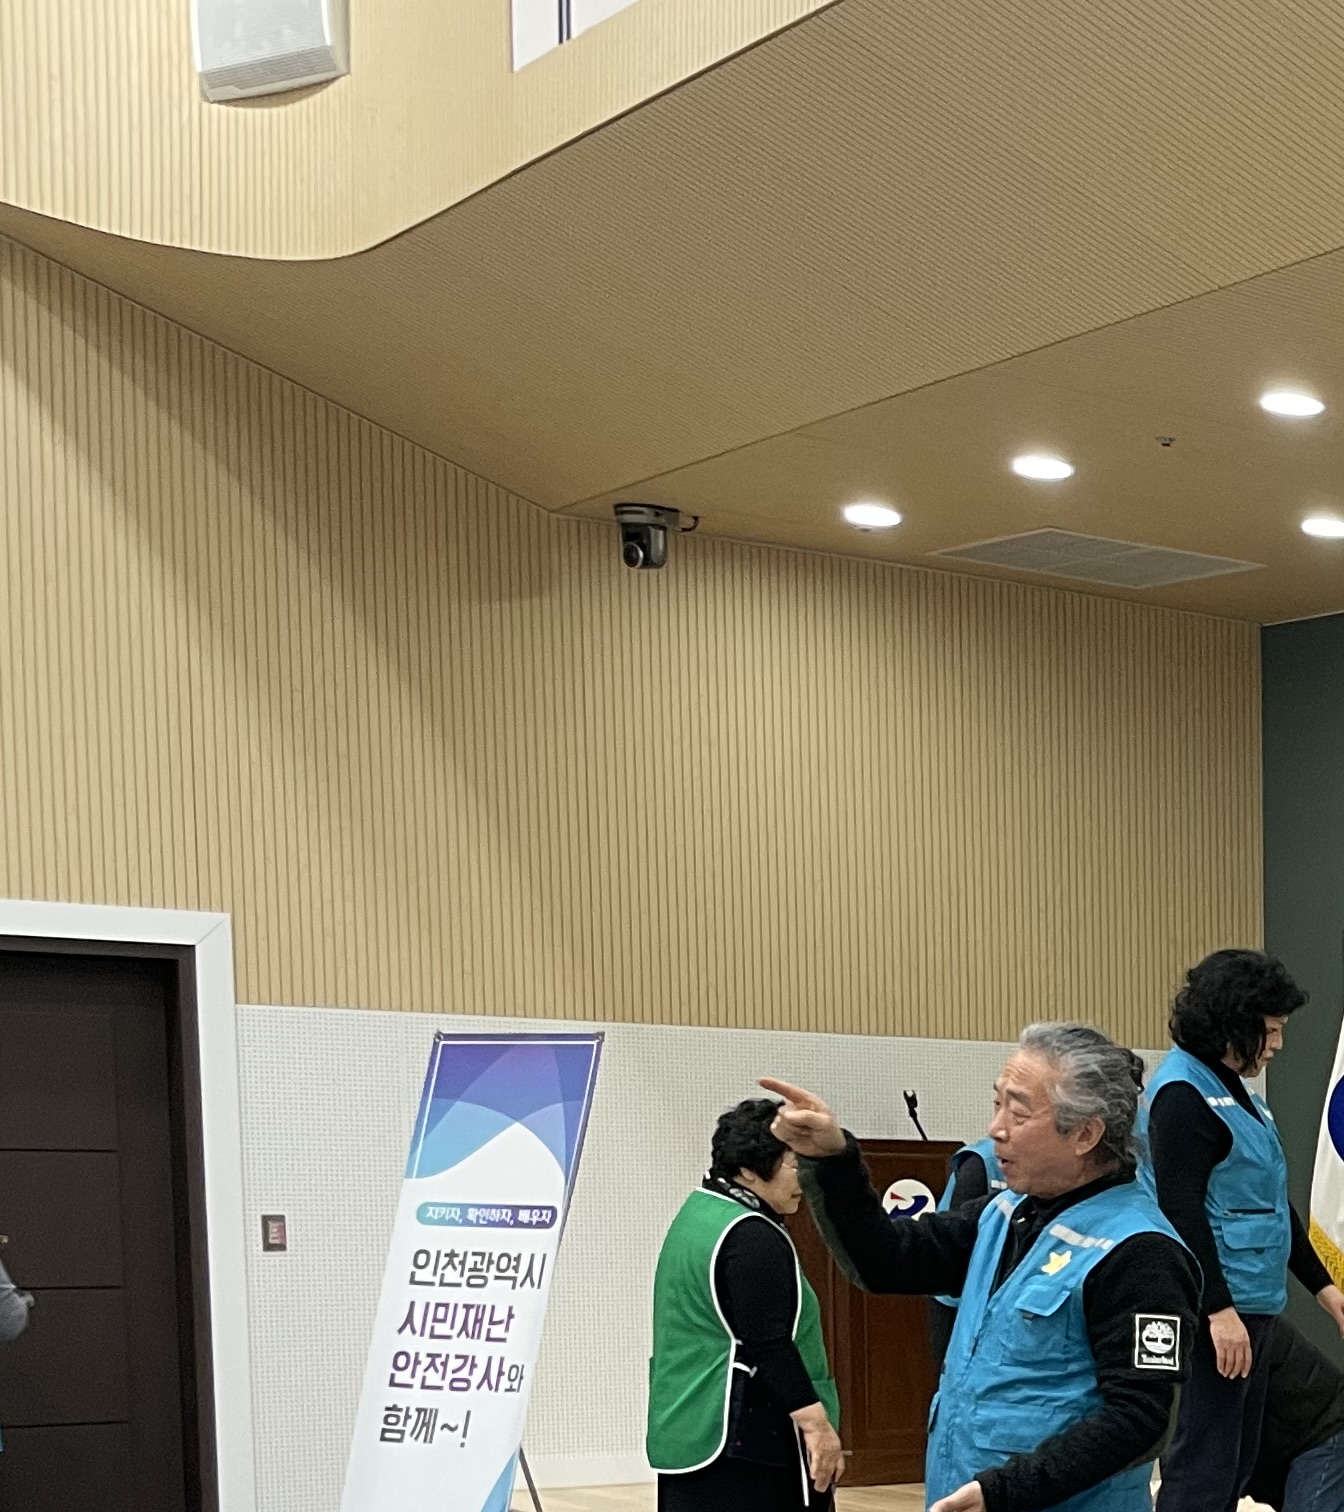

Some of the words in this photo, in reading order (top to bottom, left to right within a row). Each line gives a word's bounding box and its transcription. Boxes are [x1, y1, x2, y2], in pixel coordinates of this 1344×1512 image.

[409, 1248, 547, 1290] 인천광역시
[397, 1300, 516, 1343] 시민재난
[388, 1350, 525, 1393] 안전강사와
[379, 1403, 472, 1448] 함께~!
